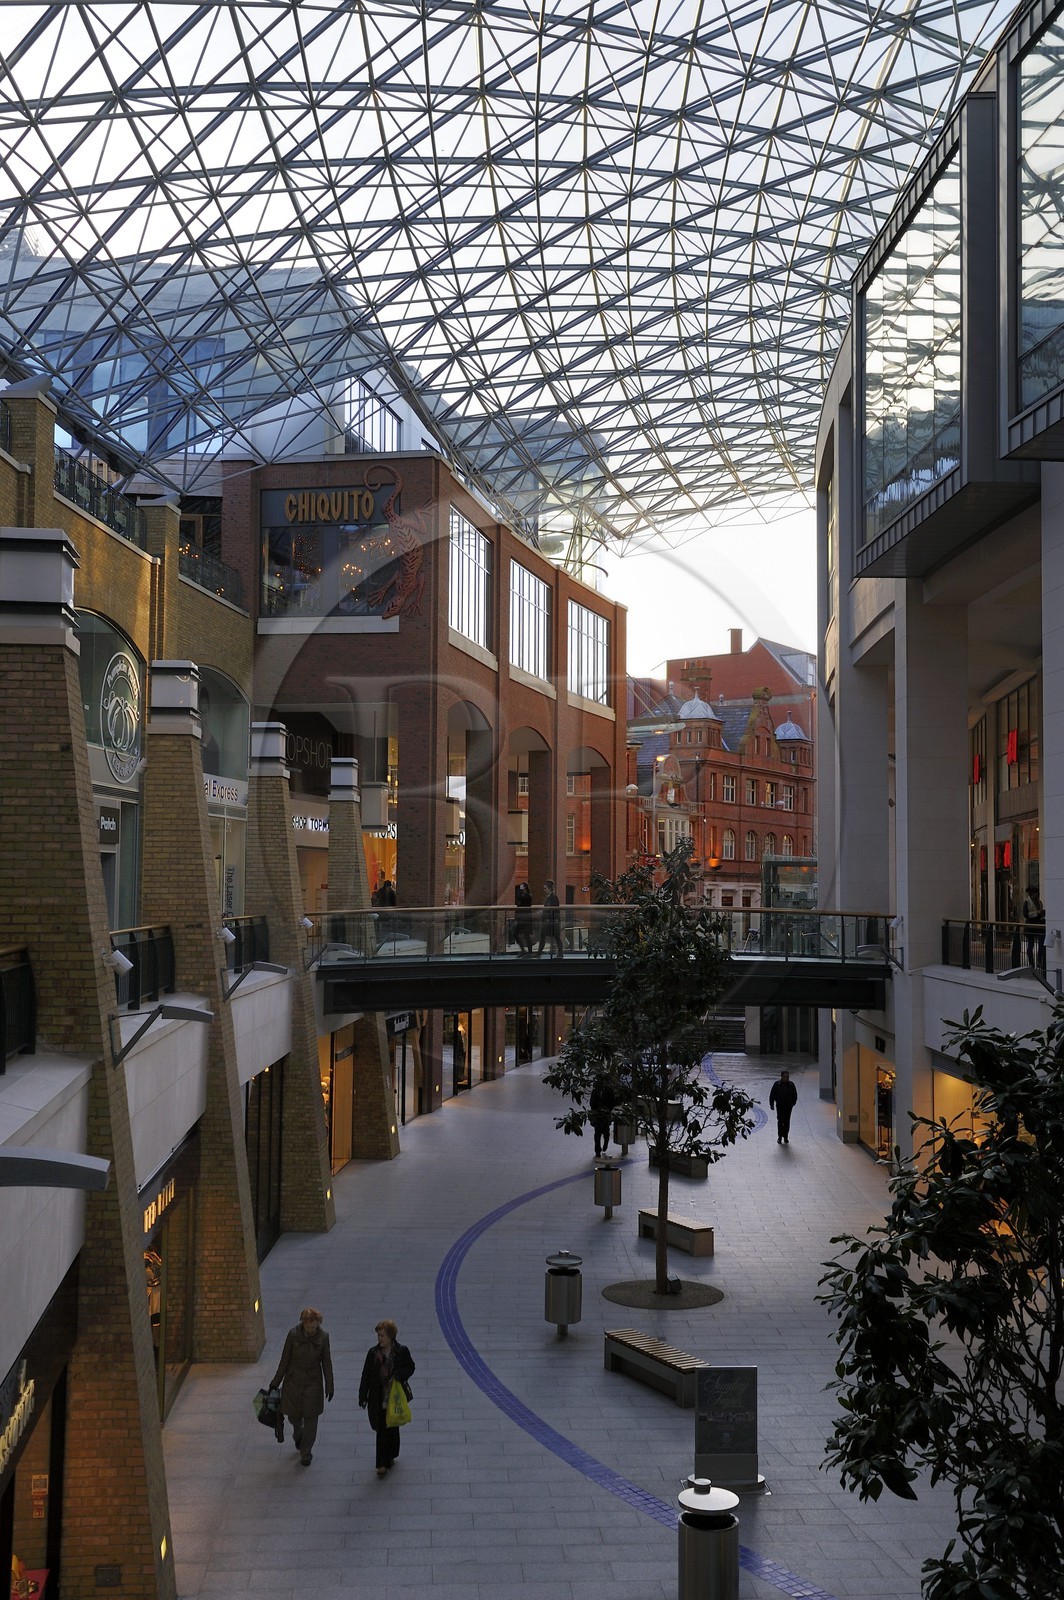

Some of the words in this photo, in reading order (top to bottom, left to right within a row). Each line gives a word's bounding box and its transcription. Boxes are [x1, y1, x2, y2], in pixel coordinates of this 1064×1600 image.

[284, 489, 375, 522] CHIQUITO
[212, 780, 238, 802] Express
[100, 815, 117, 831] Patch
[226, 866, 235, 884] The
[226, 885, 234, 910] Laser
